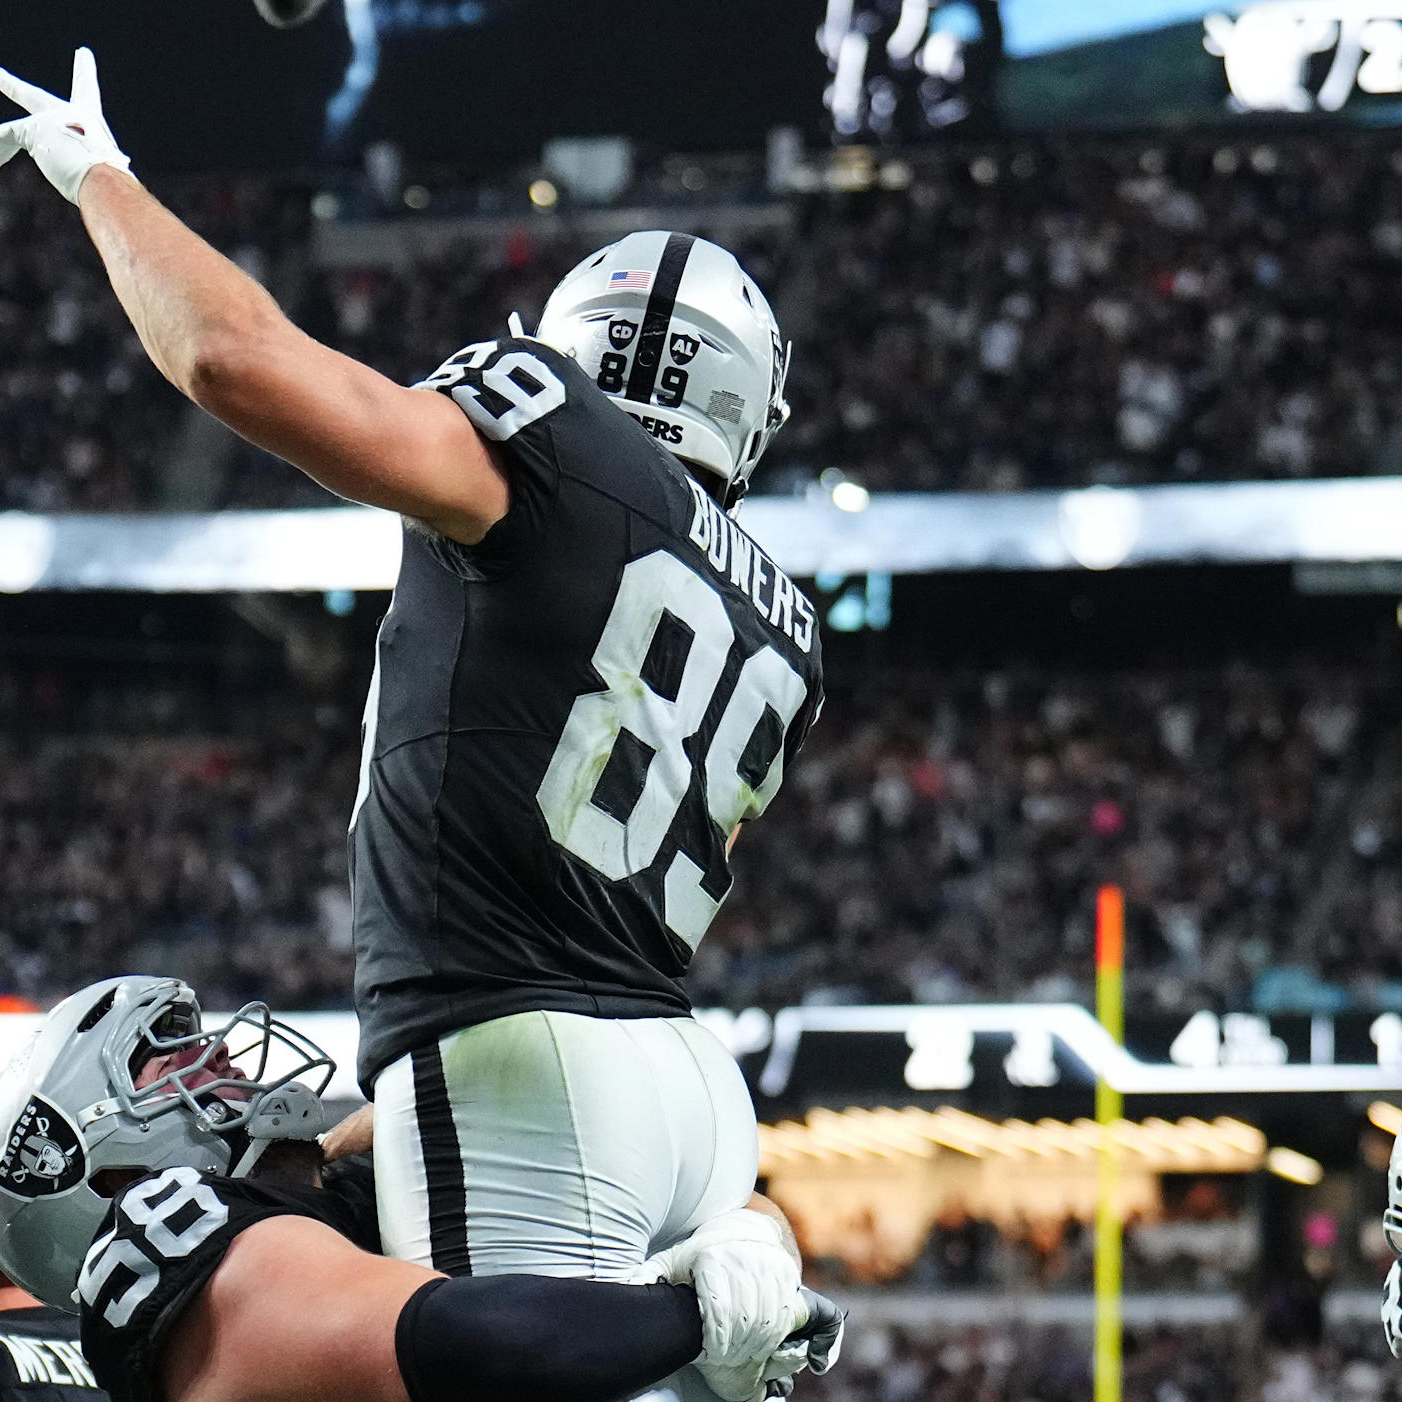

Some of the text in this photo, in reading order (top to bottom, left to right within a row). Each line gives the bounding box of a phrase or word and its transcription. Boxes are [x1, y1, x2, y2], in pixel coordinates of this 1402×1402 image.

[611, 325, 632, 339] CD
[672, 338, 694, 357] AL
[684, 475, 815, 653] BOWERS
[536, 549, 807, 955] 89
